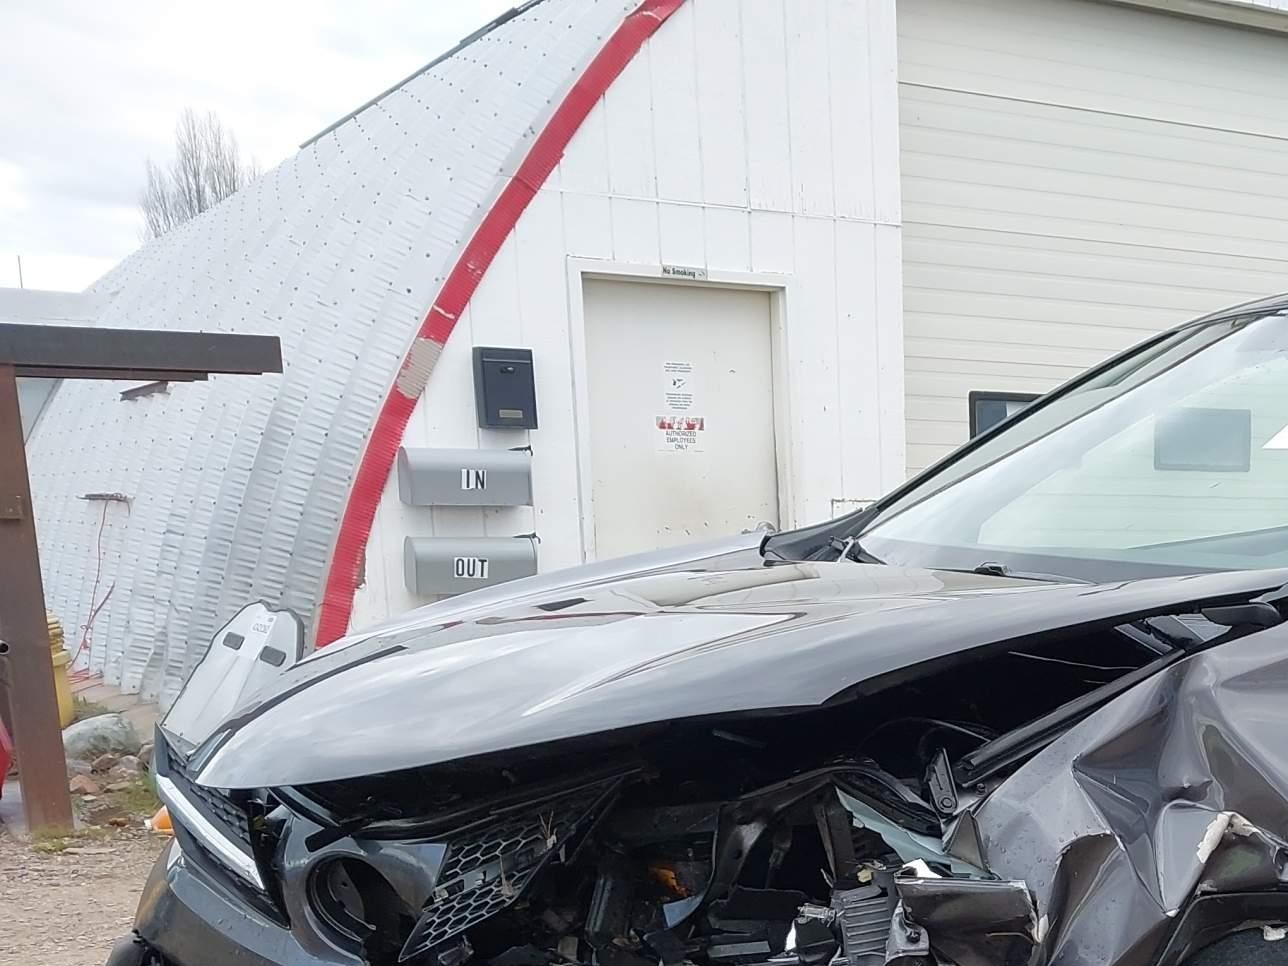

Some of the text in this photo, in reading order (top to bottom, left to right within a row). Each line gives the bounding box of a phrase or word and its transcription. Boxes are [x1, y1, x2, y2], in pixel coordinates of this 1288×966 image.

[662, 266, 696, 279] No Smoking
[466, 469, 485, 489] IN
[455, 558, 488, 578] OUT
